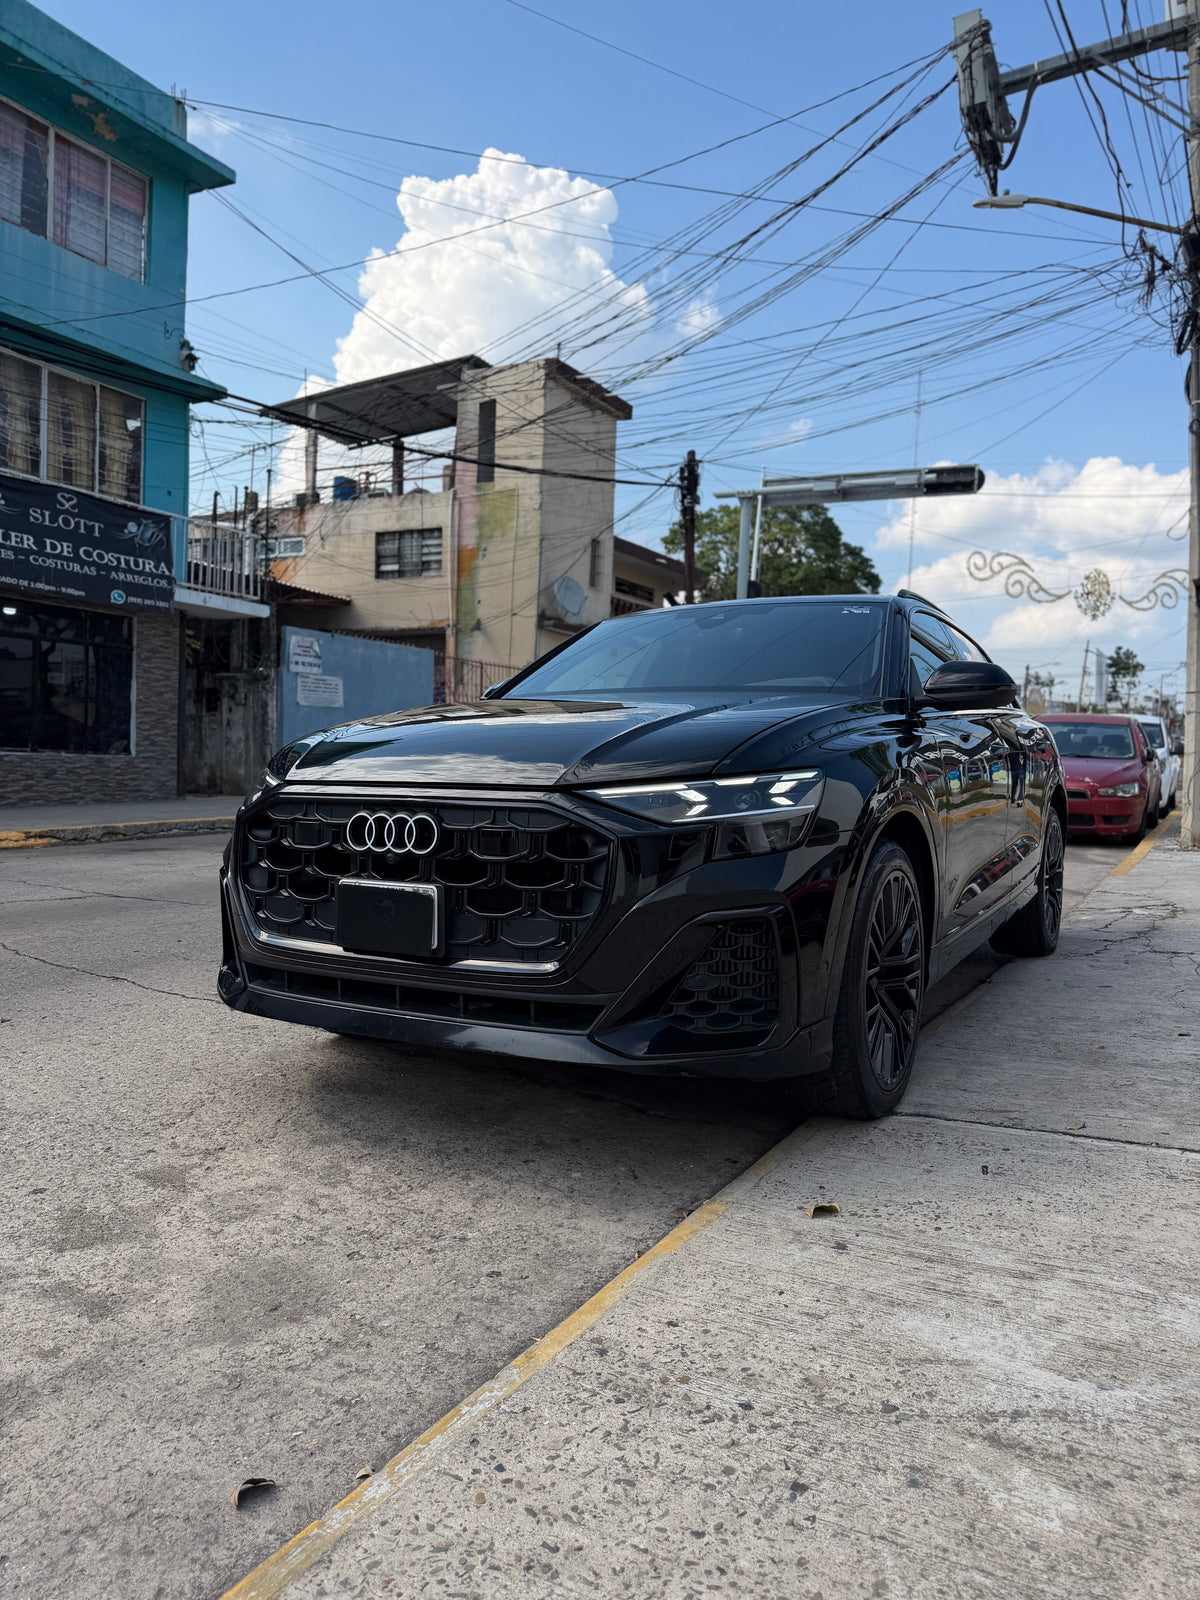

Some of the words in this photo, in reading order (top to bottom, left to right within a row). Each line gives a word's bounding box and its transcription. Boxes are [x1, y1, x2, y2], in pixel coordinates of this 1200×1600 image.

[29, 507, 104, 537] SLOTT
[0, 529, 38, 551] LER
[43, 538, 74, 557] DE
[79, 546, 170, 576] COSTURA
[29, 555, 97, 576] COSTURAS
[19, 579, 29, 587] DE
